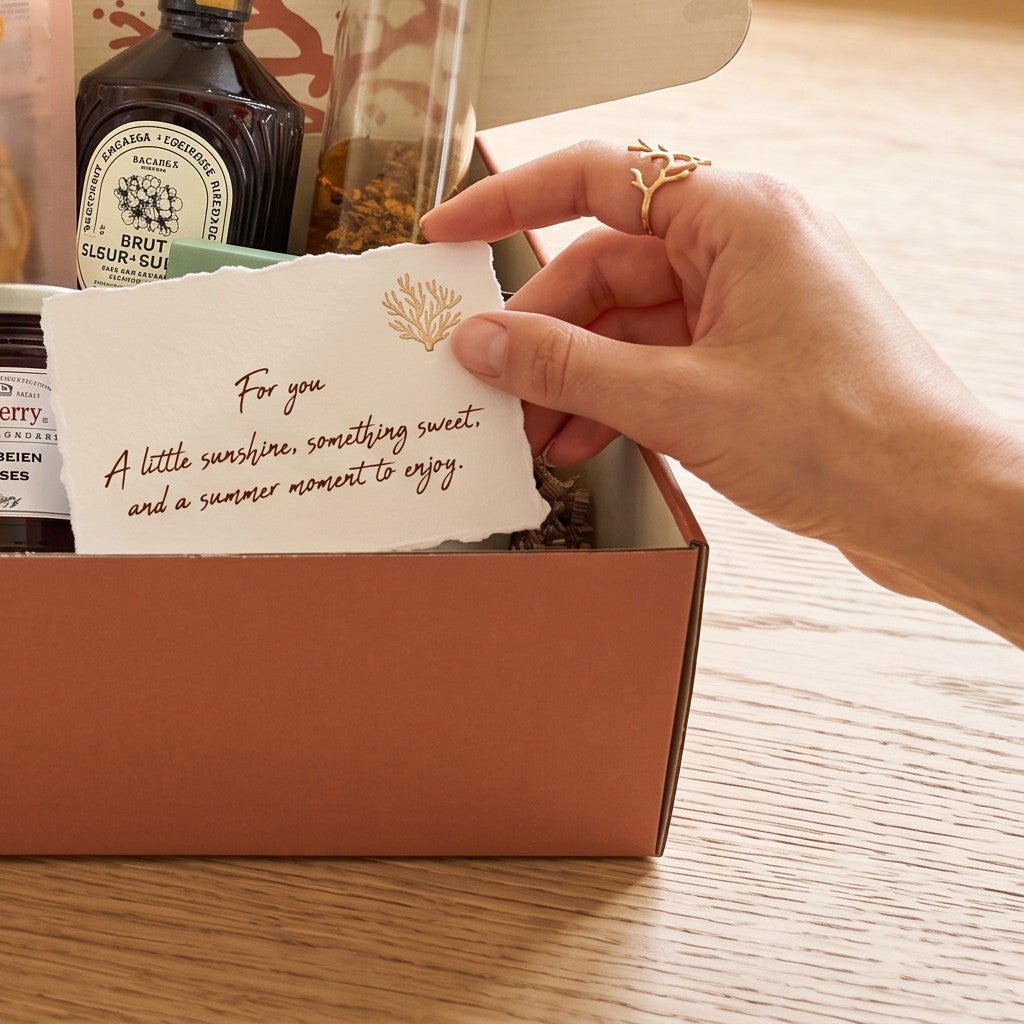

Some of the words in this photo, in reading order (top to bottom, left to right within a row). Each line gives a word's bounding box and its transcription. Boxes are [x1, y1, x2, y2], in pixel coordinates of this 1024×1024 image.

[120, 234, 168, 253] BRUT
[234, 367, 278, 414] For
[288, 377, 326, 415] you
[104, 450, 132, 491] A
[140, 441, 193, 476] little
[200, 431, 297, 471] sunshine,
[307, 414, 408, 455] something
[417, 404, 485, 439] sweet,
[127, 485, 169, 517] and
[175, 495, 191, 511] a
[200, 479, 281, 509] summer
[288, 461, 367, 496] moment
[375, 457, 396, 483] to
[404, 456, 464, 495] enjoy.
